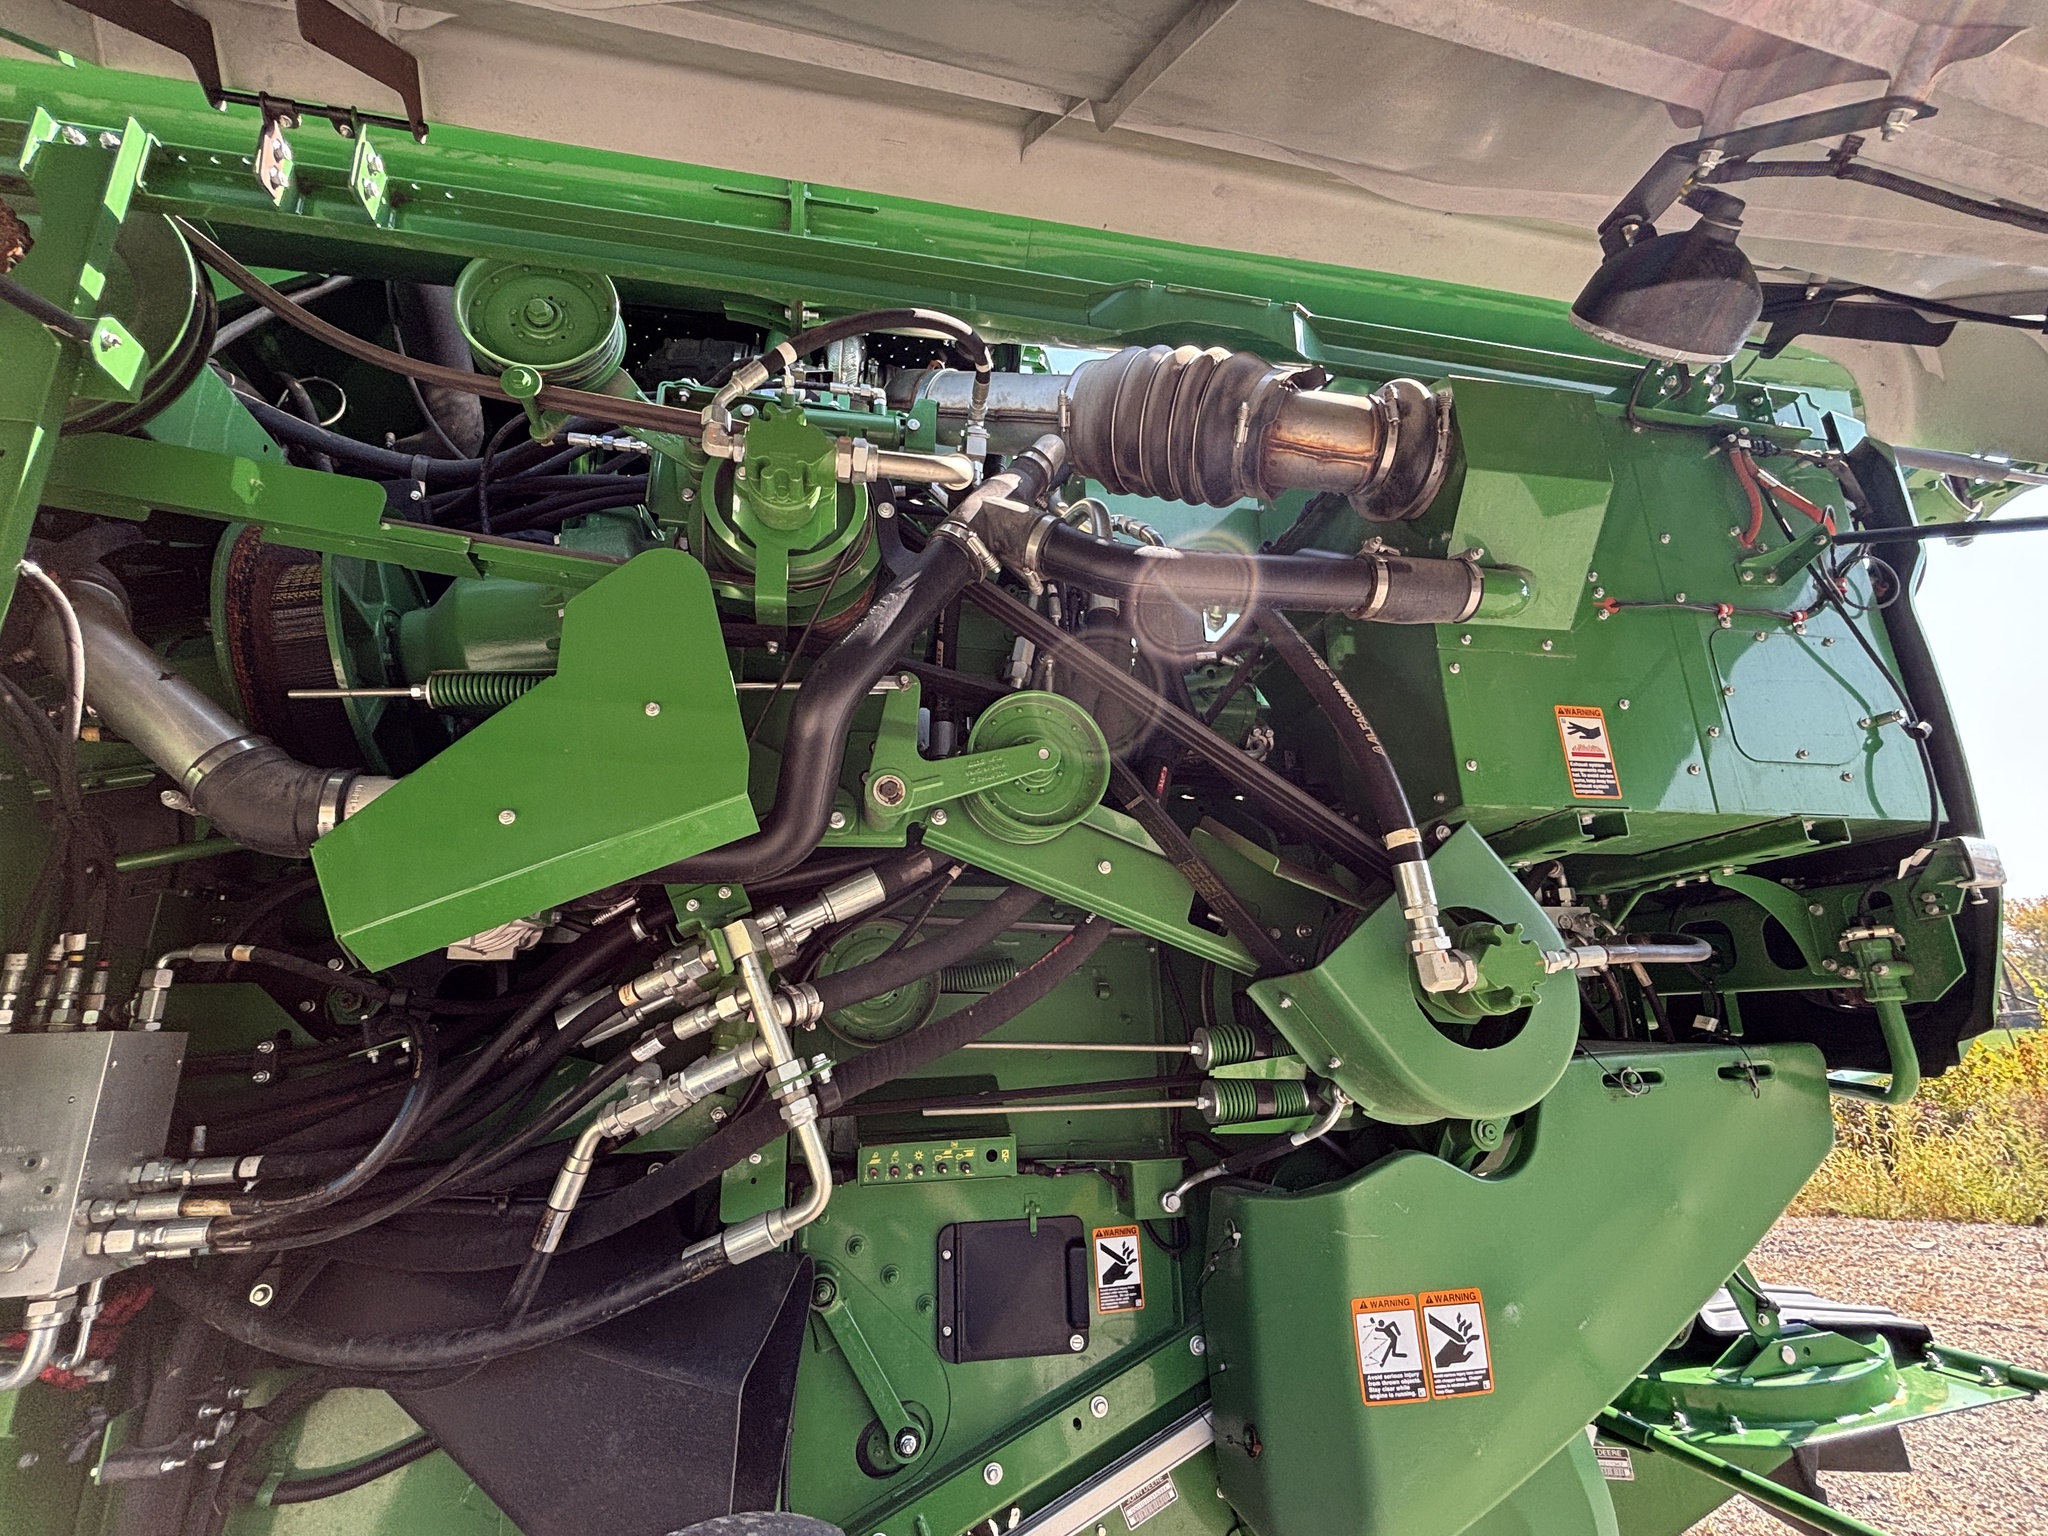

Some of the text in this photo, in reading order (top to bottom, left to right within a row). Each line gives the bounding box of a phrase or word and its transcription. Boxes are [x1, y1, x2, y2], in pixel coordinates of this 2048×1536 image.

[1332, 679, 1381, 746] ALFAGOMMA
[1565, 708, 1600, 716] WARNING
[1103, 1227, 1137, 1236] WARNING
[1434, 1292, 1476, 1303] WARNING
[1370, 1298, 1410, 1308] WARNING
[1597, 1449, 1622, 1457] DEERE
